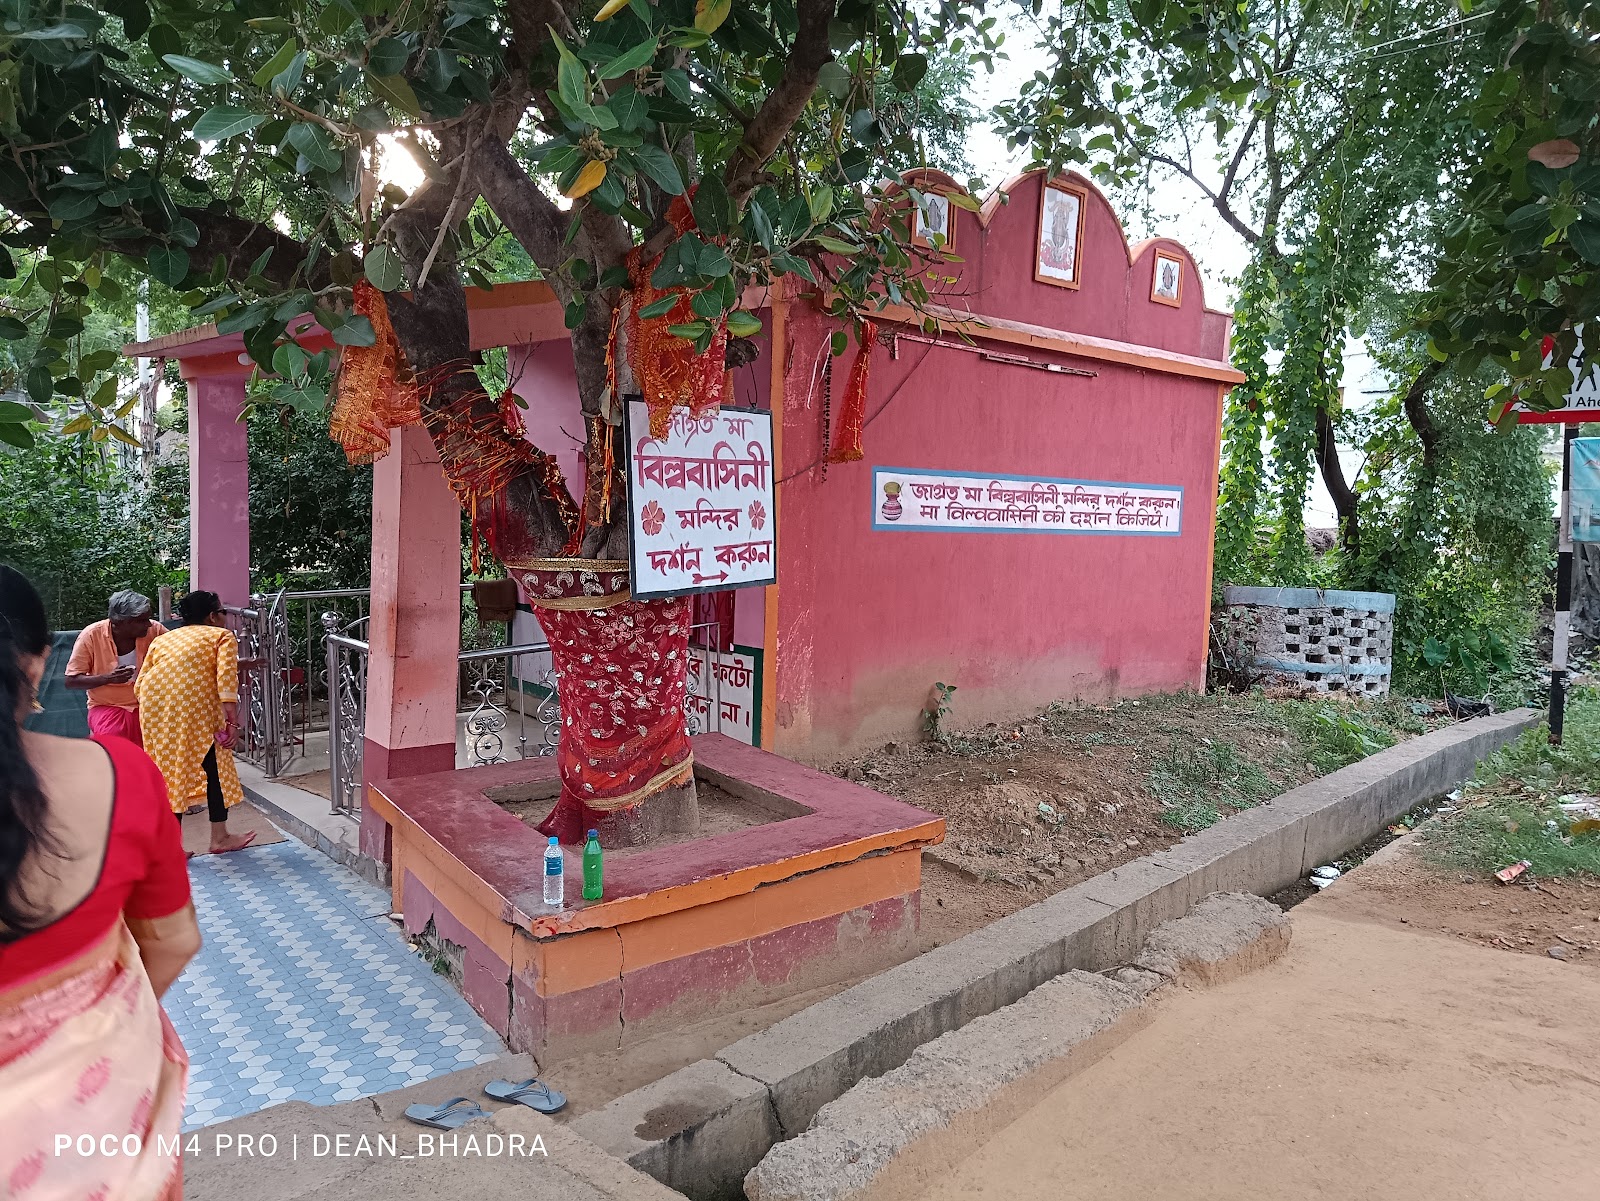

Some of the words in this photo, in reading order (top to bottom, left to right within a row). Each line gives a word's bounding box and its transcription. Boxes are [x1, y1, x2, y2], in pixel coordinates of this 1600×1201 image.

[723, 417, 753, 441] মা
[633, 439, 770, 492] বিল্ববাসিনী
[909, 482, 960, 501] জাগ্রত
[963, 486, 983, 503] মা
[987, 480, 1060, 505] বিল্ববাসিনী
[1062, 486, 1101, 510] মন্দির
[1104, 491, 1136, 508] দর্শন
[675, 497, 742, 531] মন্দির
[920, 504, 940, 520] मा
[1070, 507, 1112, 528] दर्शन
[646, 541, 704, 576] দর্শন
[714, 539, 772, 571] করুন
